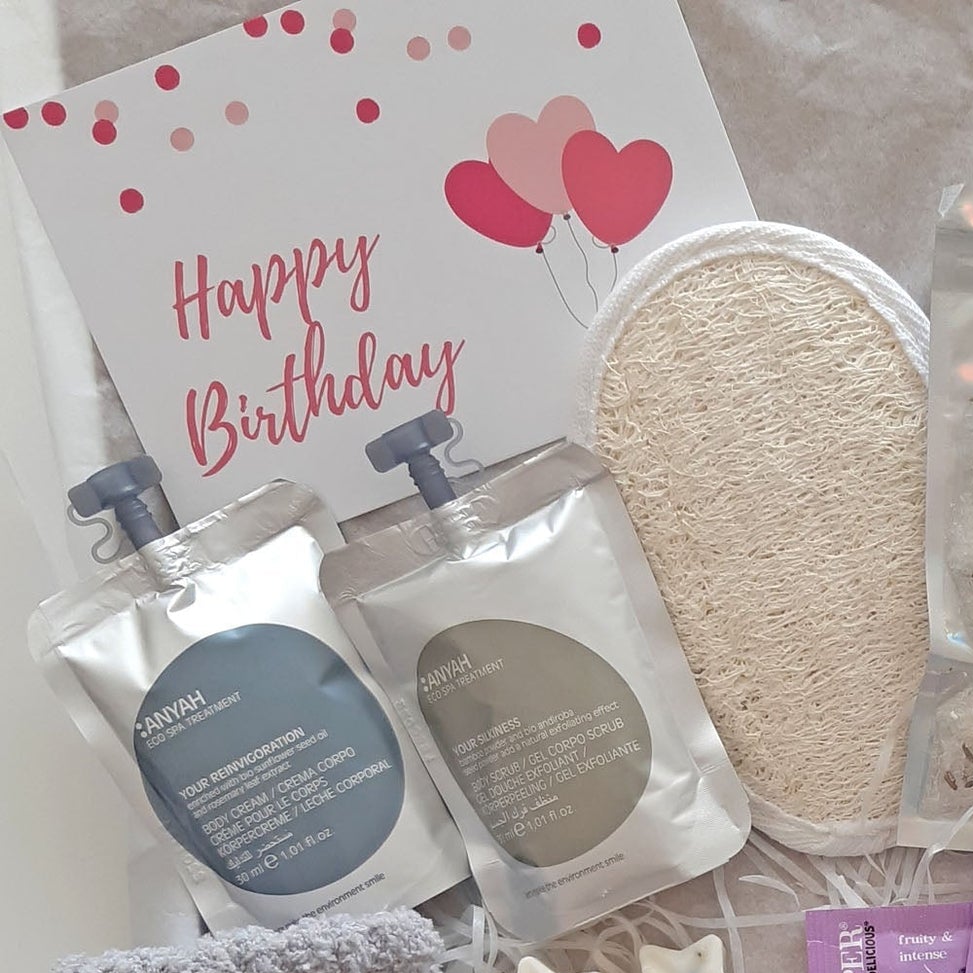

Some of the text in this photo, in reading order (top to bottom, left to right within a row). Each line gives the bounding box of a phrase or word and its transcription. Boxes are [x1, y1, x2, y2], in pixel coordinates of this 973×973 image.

[172, 233, 380, 341] Happy
[186, 320, 465, 478] Birthday
[456, 658, 504, 688] TREATMENT
[146, 691, 242, 749] ECO SPA TREATMENT
[452, 716, 522, 756] YOUR SILKINESS
[550, 712, 593, 736] exfoliating
[178, 726, 306, 800] YOUR REINVIGORATION
[187, 786, 220, 811] enriched
[220, 777, 240, 792] with
[254, 748, 296, 774] sunflower
[296, 735, 317, 751] seed
[489, 774, 526, 798] DOUCHE
[526, 751, 580, 782] EXFOLIANT
[490, 761, 520, 784] SCRUB
[528, 752, 550, 766] GEL
[548, 734, 586, 757] CORPO
[586, 716, 624, 741] SCRUB
[555, 739, 642, 783] GEL EXFOLIANTE
[202, 746, 356, 835] BODY CREAM CREMA CORPO
[208, 786, 244, 811] rosemary
[261, 760, 292, 781] extract
[246, 804, 277, 829] POUR
[277, 796, 290, 810] LE
[290, 776, 329, 802] CORPS
[300, 788, 334, 813] LECHE
[336, 759, 392, 794] CORPORAL
[234, 874, 248, 886] 30
[251, 864, 264, 878] ml
[316, 884, 365, 914] environment
[364, 872, 386, 888] smile
[899, 931, 953, 946] fruity &
[900, 949, 948, 962] intense
